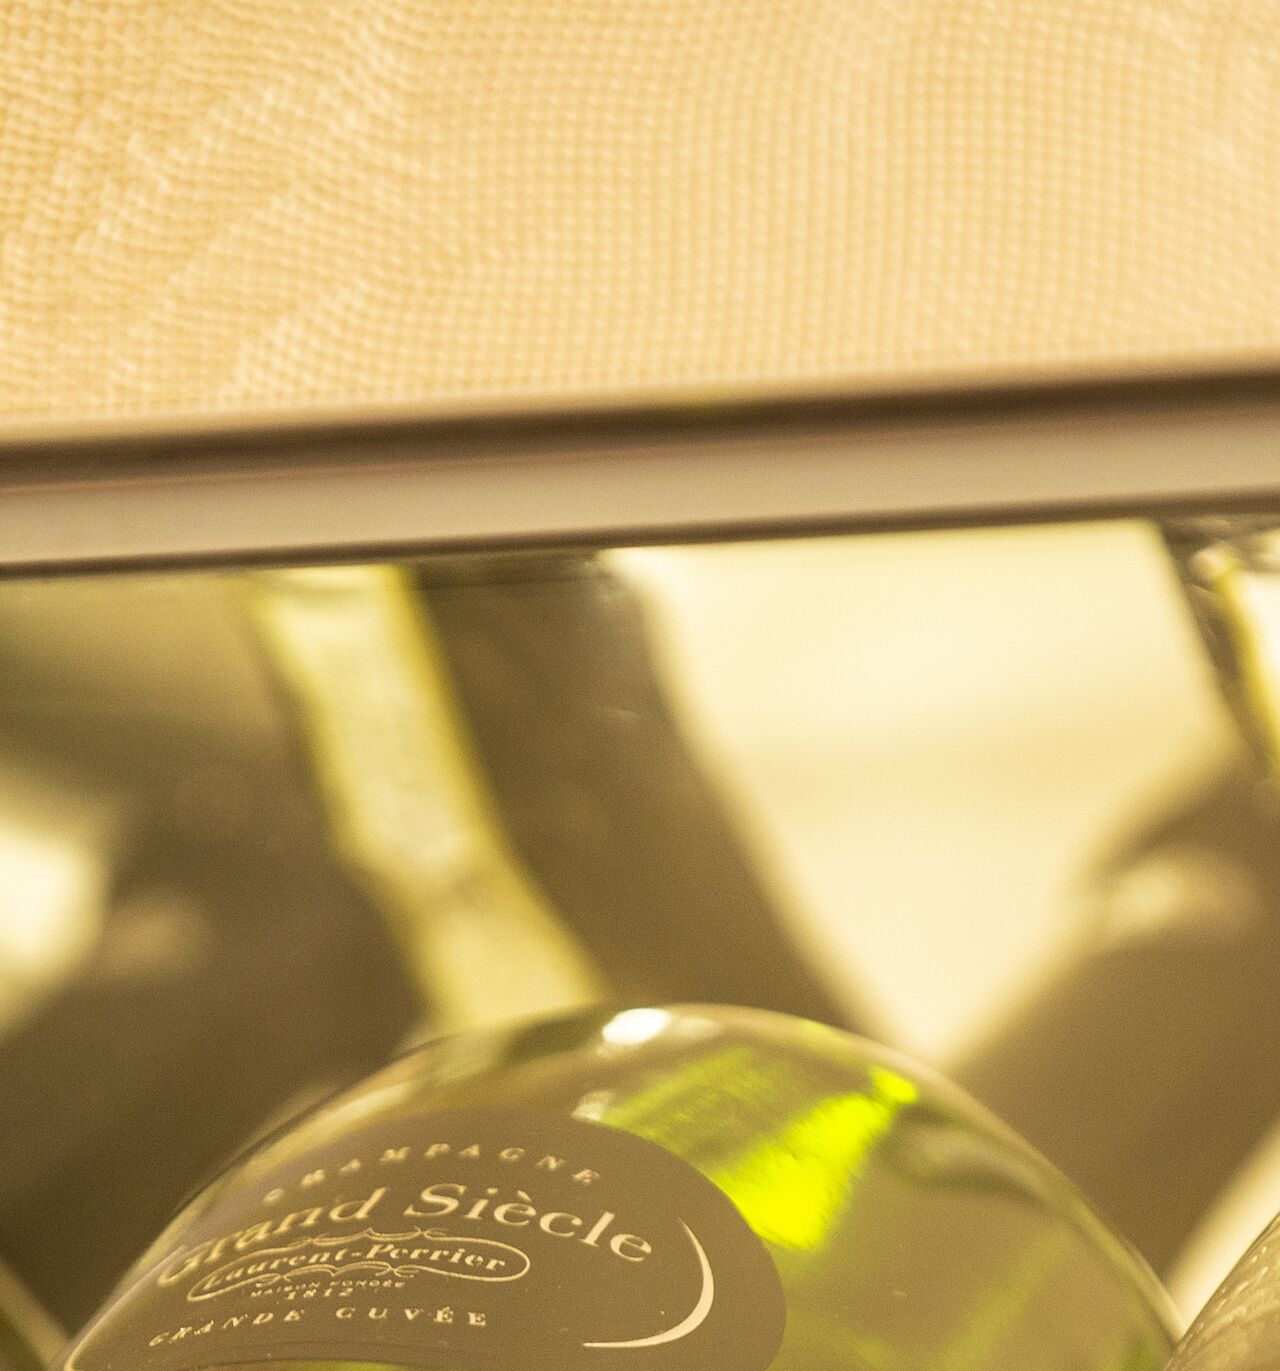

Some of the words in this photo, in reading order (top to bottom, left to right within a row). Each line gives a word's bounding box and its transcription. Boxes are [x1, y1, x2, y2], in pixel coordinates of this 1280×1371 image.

[261, 1141, 601, 1205] CHAMPAGNE
[156, 1186, 389, 1287] Grand
[403, 1183, 653, 1263] Siècle
[202, 1243, 507, 1291] Laurent-Perrier
[286, 1286, 356, 1301] 1812
[147, 1308, 307, 1348] GRANDE
[334, 1305, 488, 1328] CUVÉE
